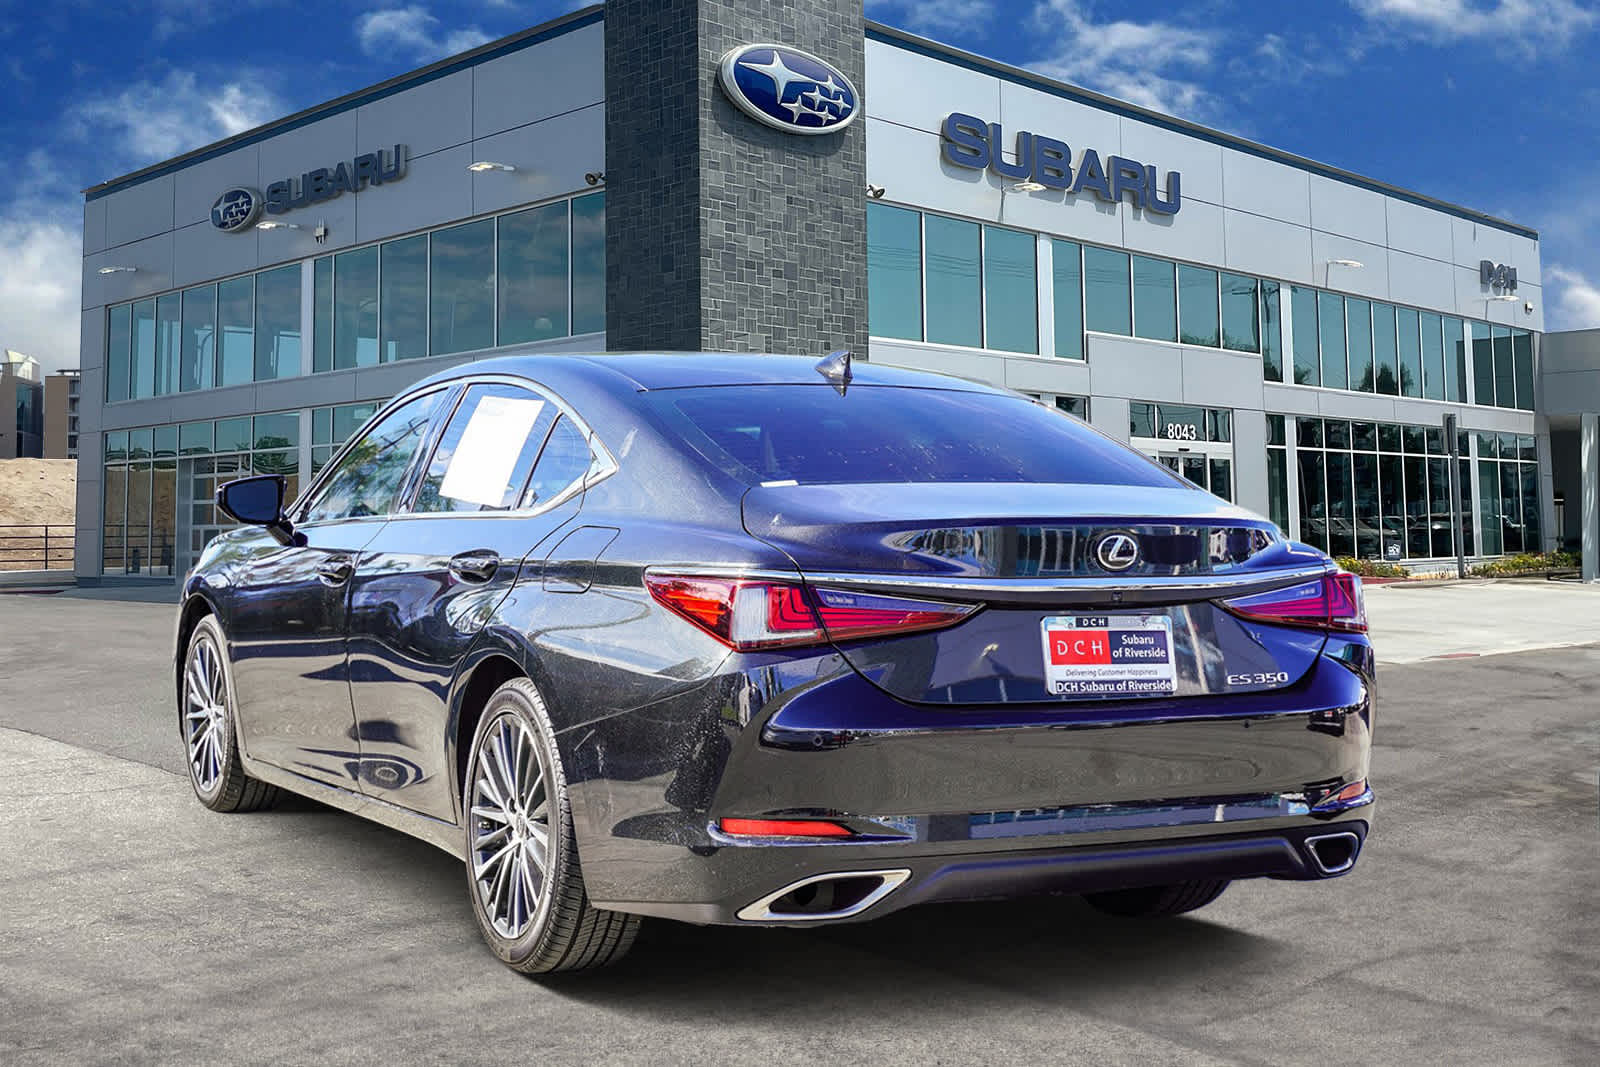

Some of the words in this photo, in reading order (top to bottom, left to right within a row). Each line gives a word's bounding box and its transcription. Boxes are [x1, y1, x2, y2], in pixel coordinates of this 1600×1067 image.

[940, 112, 1181, 215] SUBARU
[265, 143, 408, 215] SUBARU
[1167, 423, 1196, 440] 8043
[1082, 618, 1105, 626] DCH
[1121, 634, 1155, 645] Subaru
[1056, 640, 1104, 656] DCH
[1112, 648, 1122, 657] of
[1124, 647, 1167, 659] Riverside
[1065, 669, 1097, 677] Delivering
[1097, 668, 1127, 676] Customer
[1127, 668, 1158, 676] Happiness
[1227, 674, 1252, 685] ES
[1253, 671, 1289, 684] 350
[1056, 682, 1079, 692] DCH
[1080, 681, 1115, 692] Subaru
[1116, 680, 1127, 691] of
[1128, 680, 1173, 691] Riverside
